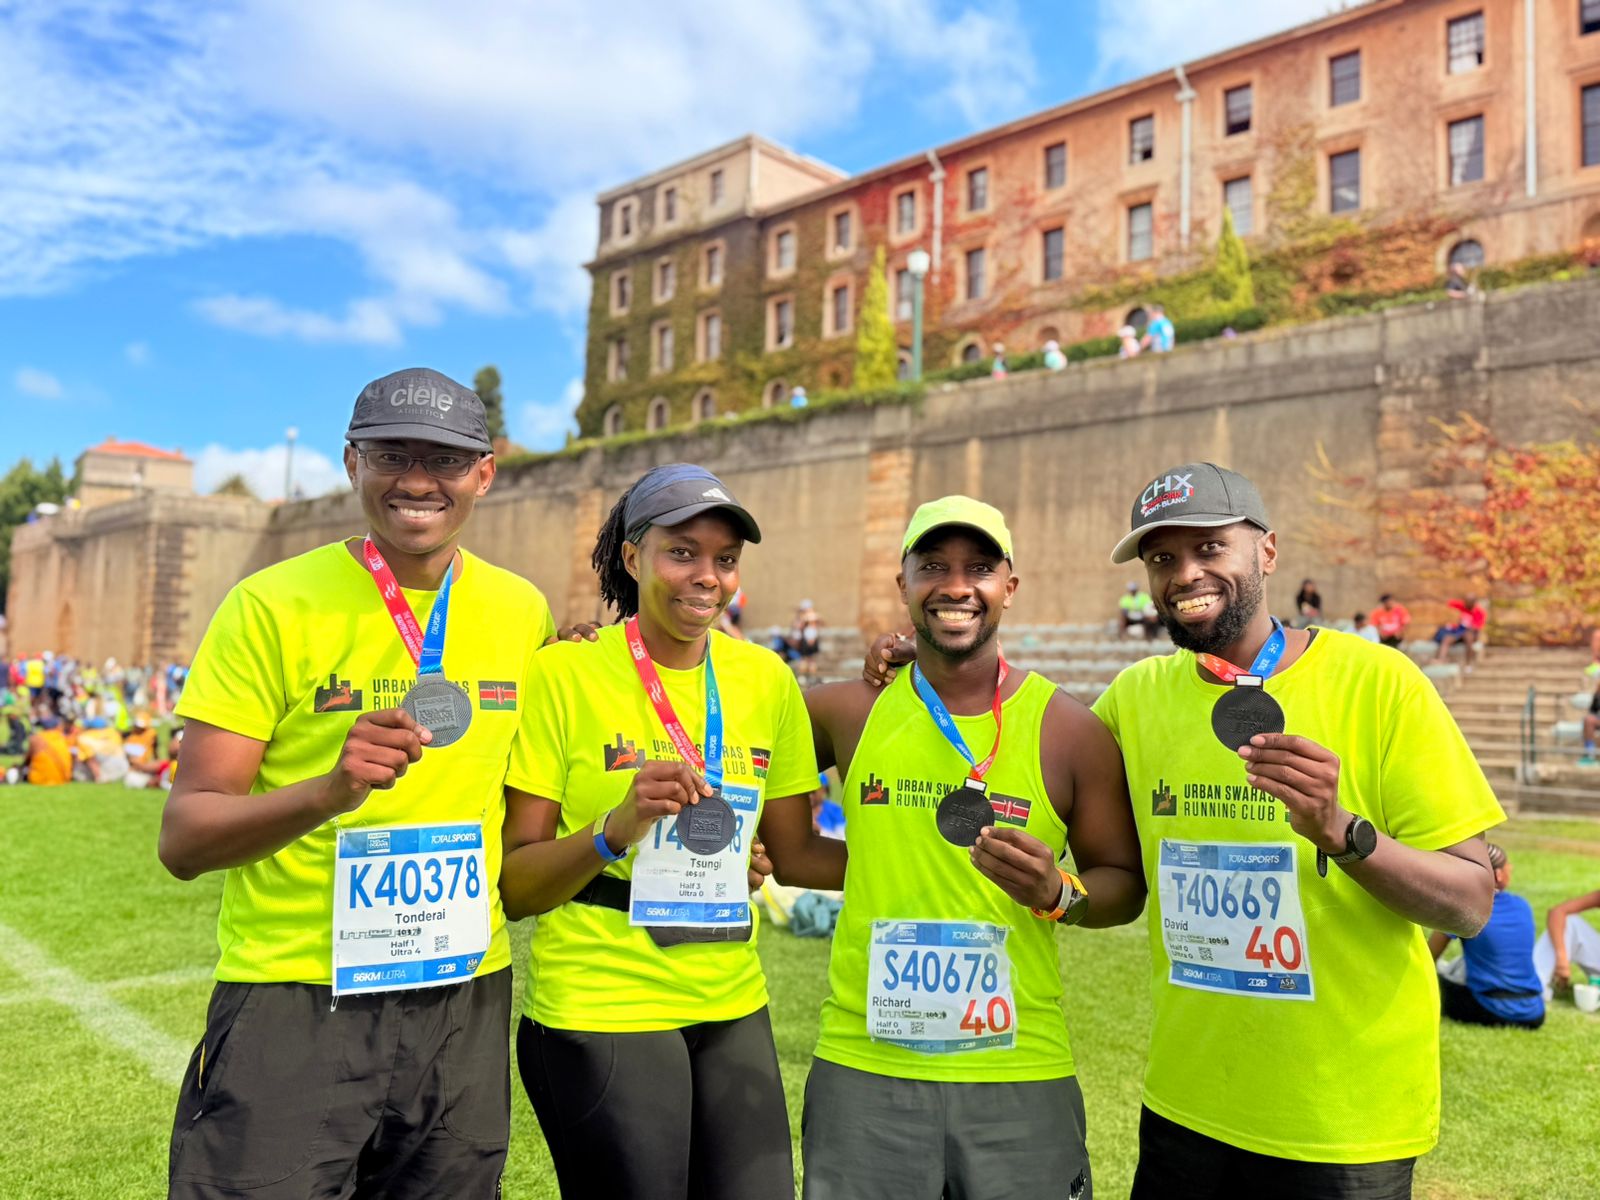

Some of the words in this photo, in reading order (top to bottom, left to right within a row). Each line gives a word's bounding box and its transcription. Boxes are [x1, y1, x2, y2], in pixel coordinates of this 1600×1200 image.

[398, 408, 444, 419] ATHLETICS
[1141, 473, 1193, 505] CHX
[725, 761, 746, 775] LUB
[897, 779, 932, 794] URBAN
[1184, 784, 1221, 799] URBAN
[896, 793, 939, 809] RUNNIN
[1184, 802, 1236, 818] RUNNING
[1242, 804, 1275, 821] CLUB
[431, 833, 477, 844] TOTALSPORTS
[690, 858, 721, 870] Tsungi
[1228, 854, 1280, 864] TOTALSPORTS
[350, 854, 480, 909] K40378
[679, 882, 695, 890] Half
[1171, 872, 1281, 920] T40669
[395, 909, 446, 924] Tonderai
[1164, 918, 1189, 931] David
[391, 940, 408, 948] Half
[1245, 926, 1302, 970] 40
[437, 963, 456, 975] 2026
[882, 949, 998, 994] S40678
[1248, 978, 1268, 987] 2026
[872, 996, 911, 1008] Richard
[959, 995, 1011, 1036] 40
